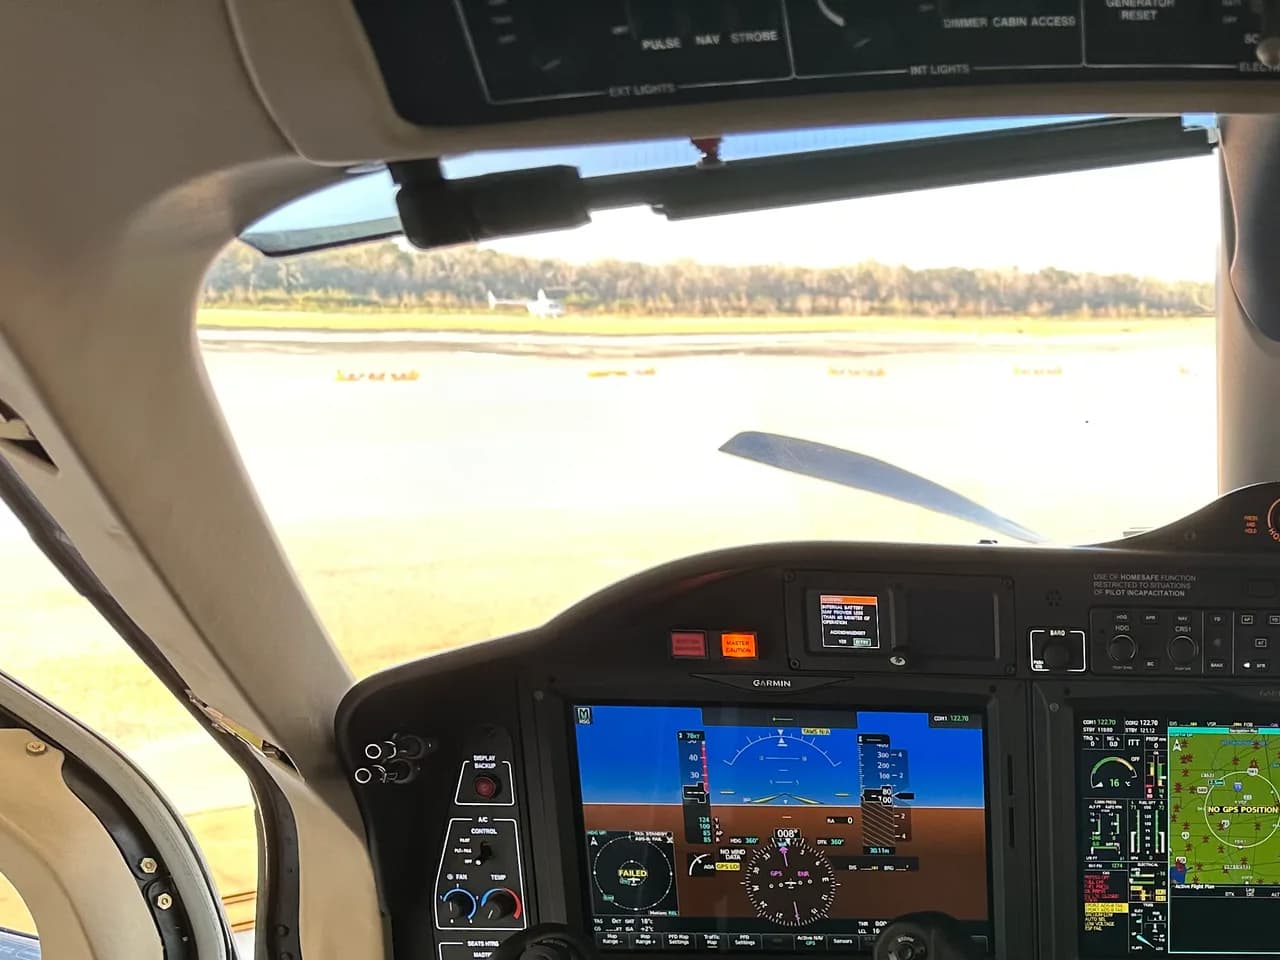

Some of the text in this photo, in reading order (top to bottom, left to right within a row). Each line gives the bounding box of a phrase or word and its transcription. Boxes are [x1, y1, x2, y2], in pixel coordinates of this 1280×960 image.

[993, 16, 1027, 27] CABIN
[1031, 15, 1076, 26] ACCESS
[1121, 10, 1158, 21] RESET
[695, 35, 720, 45] NAV
[730, 30, 778, 43] STROBE
[1121, 574, 1160, 582] HOMESAFE
[753, 679, 791, 688] GARMIN
